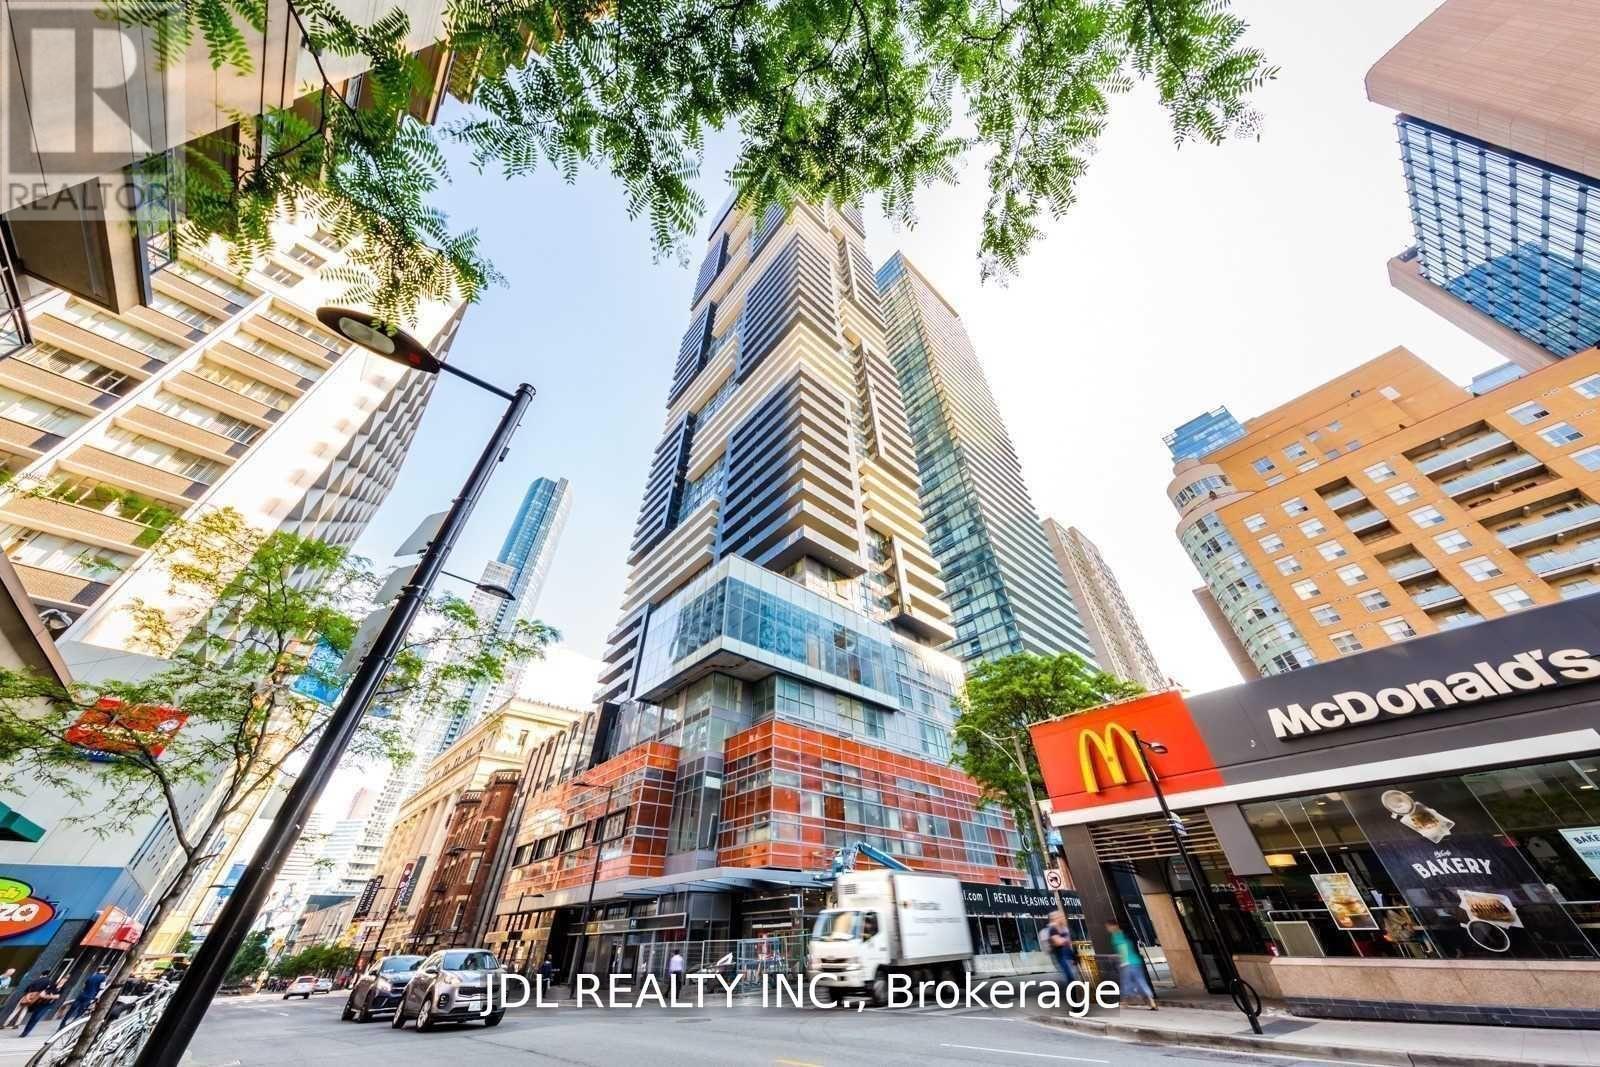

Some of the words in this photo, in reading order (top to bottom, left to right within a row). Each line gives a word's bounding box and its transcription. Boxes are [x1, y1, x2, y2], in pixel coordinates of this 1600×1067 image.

[1267, 648, 1600, 738] McDonald's
[1411, 857, 1493, 879] BAKERY
[993, 892, 1019, 904] RETAIL
[1020, 893, 1049, 907] LEASING
